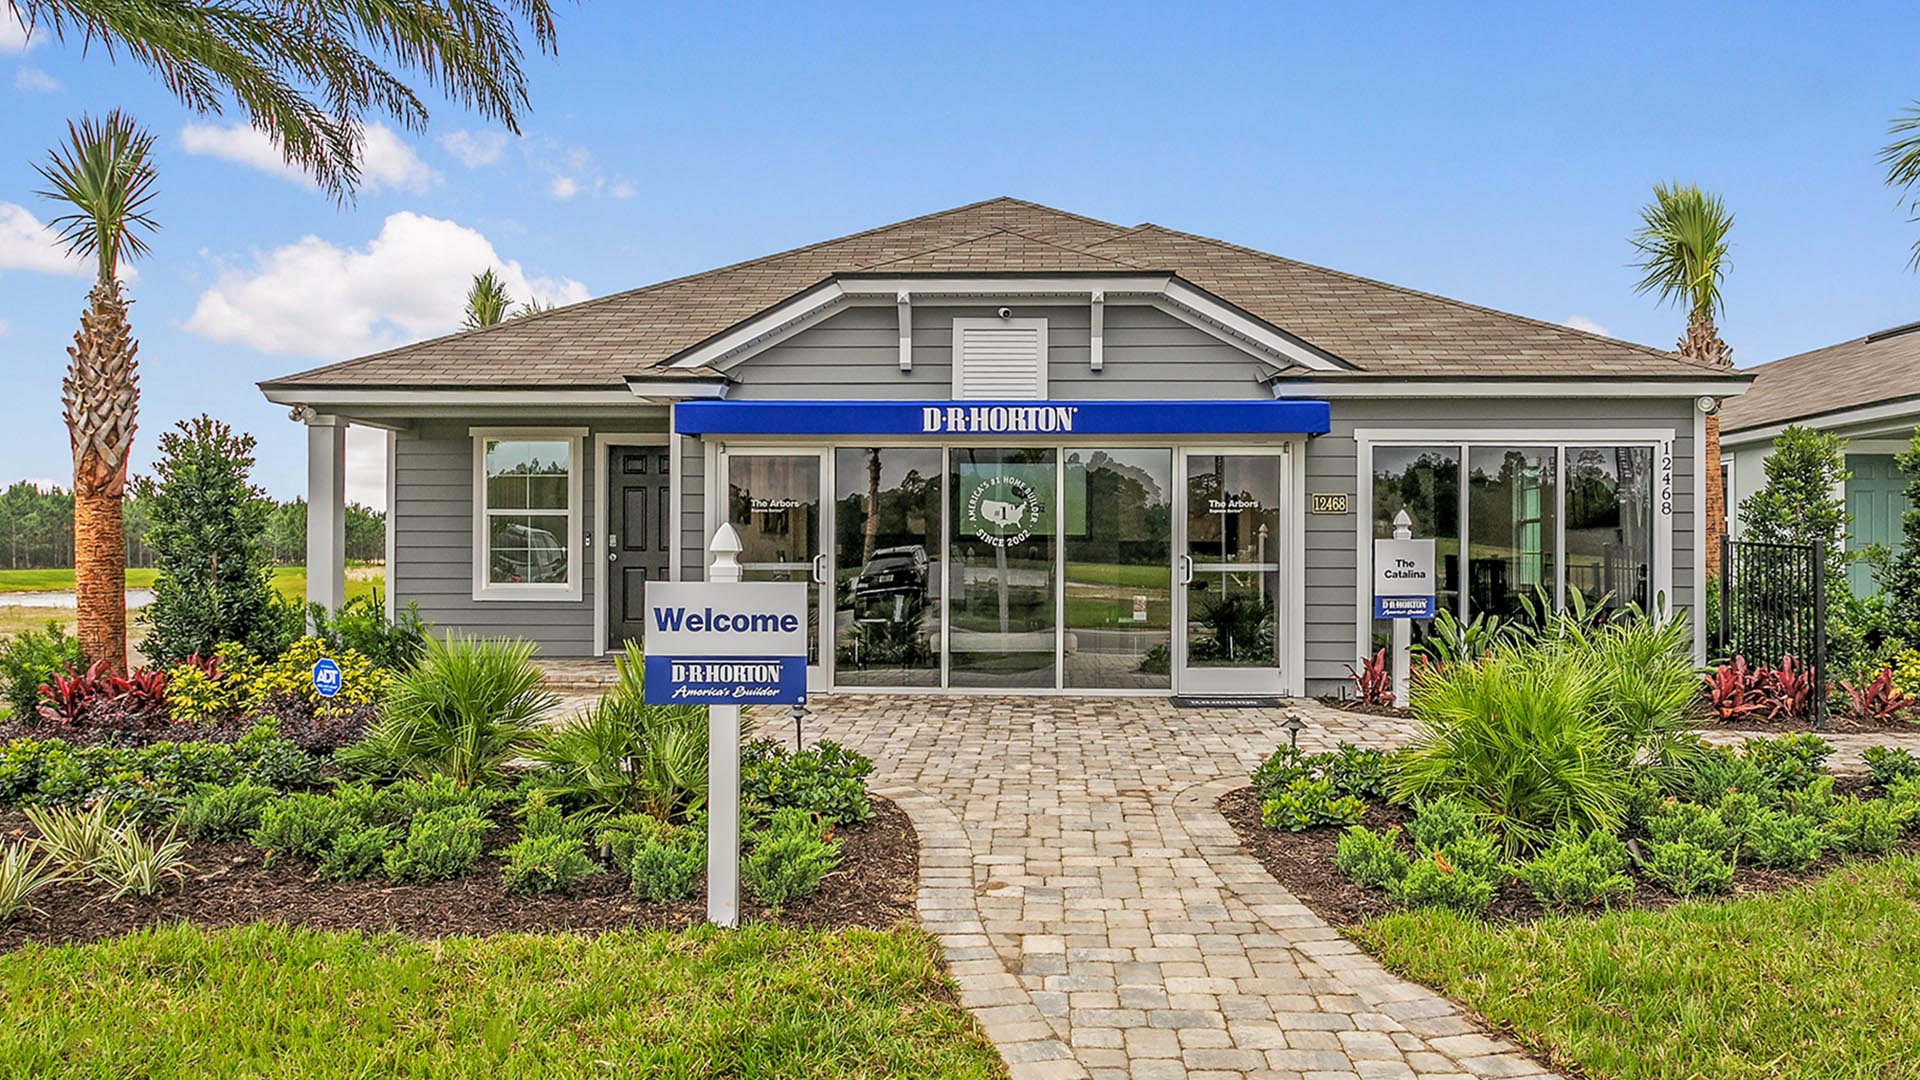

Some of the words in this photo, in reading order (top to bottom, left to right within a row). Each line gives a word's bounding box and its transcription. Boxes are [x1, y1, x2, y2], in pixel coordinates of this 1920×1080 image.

[1661, 441, 1672, 515] 12468
[751, 499, 768, 508] The
[769, 499, 800, 508] Arbors
[1003, 476, 1026, 490] HOME
[1024, 487, 1040, 523] BUILDER
[1208, 499, 1226, 508] The
[1228, 499, 1259, 508] Arbors
[1314, 496, 1346, 511] 12468
[975, 528, 1005, 547] SINCE
[1006, 529, 1031, 547] 2002
[1395, 559, 1415, 568] The
[1384, 570, 1426, 579] Catalina
[653, 607, 799, 632] Welcome
[316, 669, 338, 684] ADT
[671, 685, 730, 699] America's
[732, 686, 780, 698] Builder
